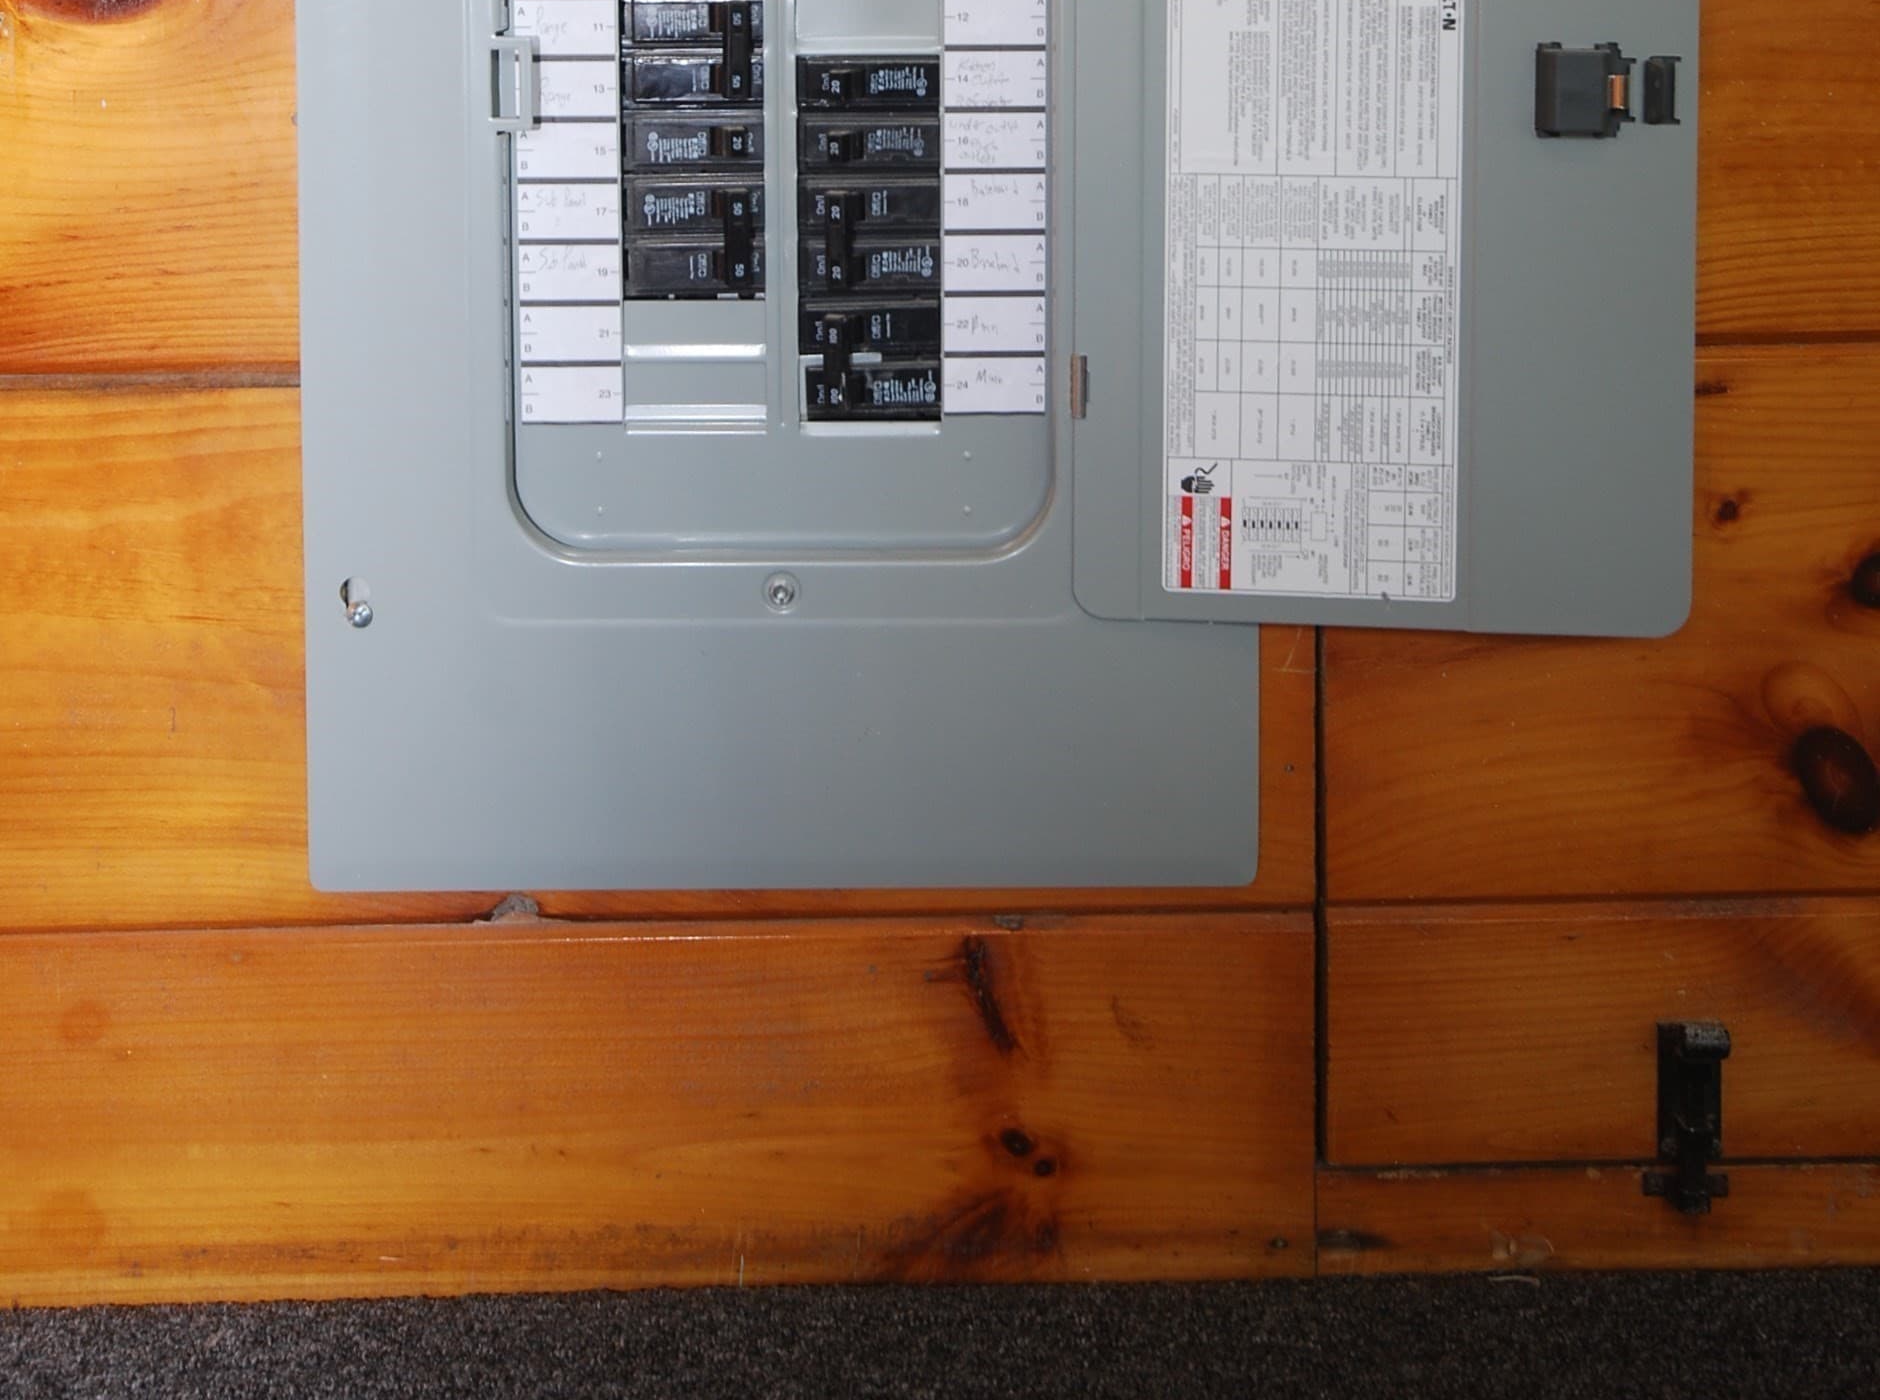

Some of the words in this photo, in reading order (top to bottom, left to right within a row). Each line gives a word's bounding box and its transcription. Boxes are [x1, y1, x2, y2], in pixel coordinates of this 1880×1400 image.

[518, 7, 526, 16] A
[732, 12, 742, 26] 50
[958, 12, 969, 22] 12
[594, 23, 604, 32] 11
[1036, 58, 1044, 66] A
[732, 74, 741, 88] 50
[958, 74, 968, 82] 14
[594, 84, 605, 94] 13
[832, 80, 840, 94] 20
[1036, 120, 1044, 128] A
[733, 136, 742, 150] 20
[594, 146, 606, 156] 15
[830, 142, 839, 155] 20
[1036, 182, 1044, 190] A
[521, 192, 528, 200] A
[596, 208, 607, 216] 17
[733, 202, 742, 216] 50
[831, 206, 840, 220] 20
[1036, 242, 1044, 252] A
[522, 253, 530, 262] A
[957, 258, 968, 268] 20
[598, 268, 608, 277] 19
[735, 264, 744, 277] 50
[832, 266, 842, 280] 20
[1036, 304, 1043, 312] A
[524, 314, 532, 324] A
[956, 320, 968, 328] 22
[599, 328, 610, 338] 21
[829, 328, 838, 344] 100
[1036, 364, 1043, 374] A
[525, 374, 532, 384] A
[956, 380, 968, 390] 24
[599, 389, 611, 398] 23
[830, 388, 838, 404] 100
[1182, 527, 1190, 572] PELIGRO
[1220, 529, 1229, 572] DANGER
